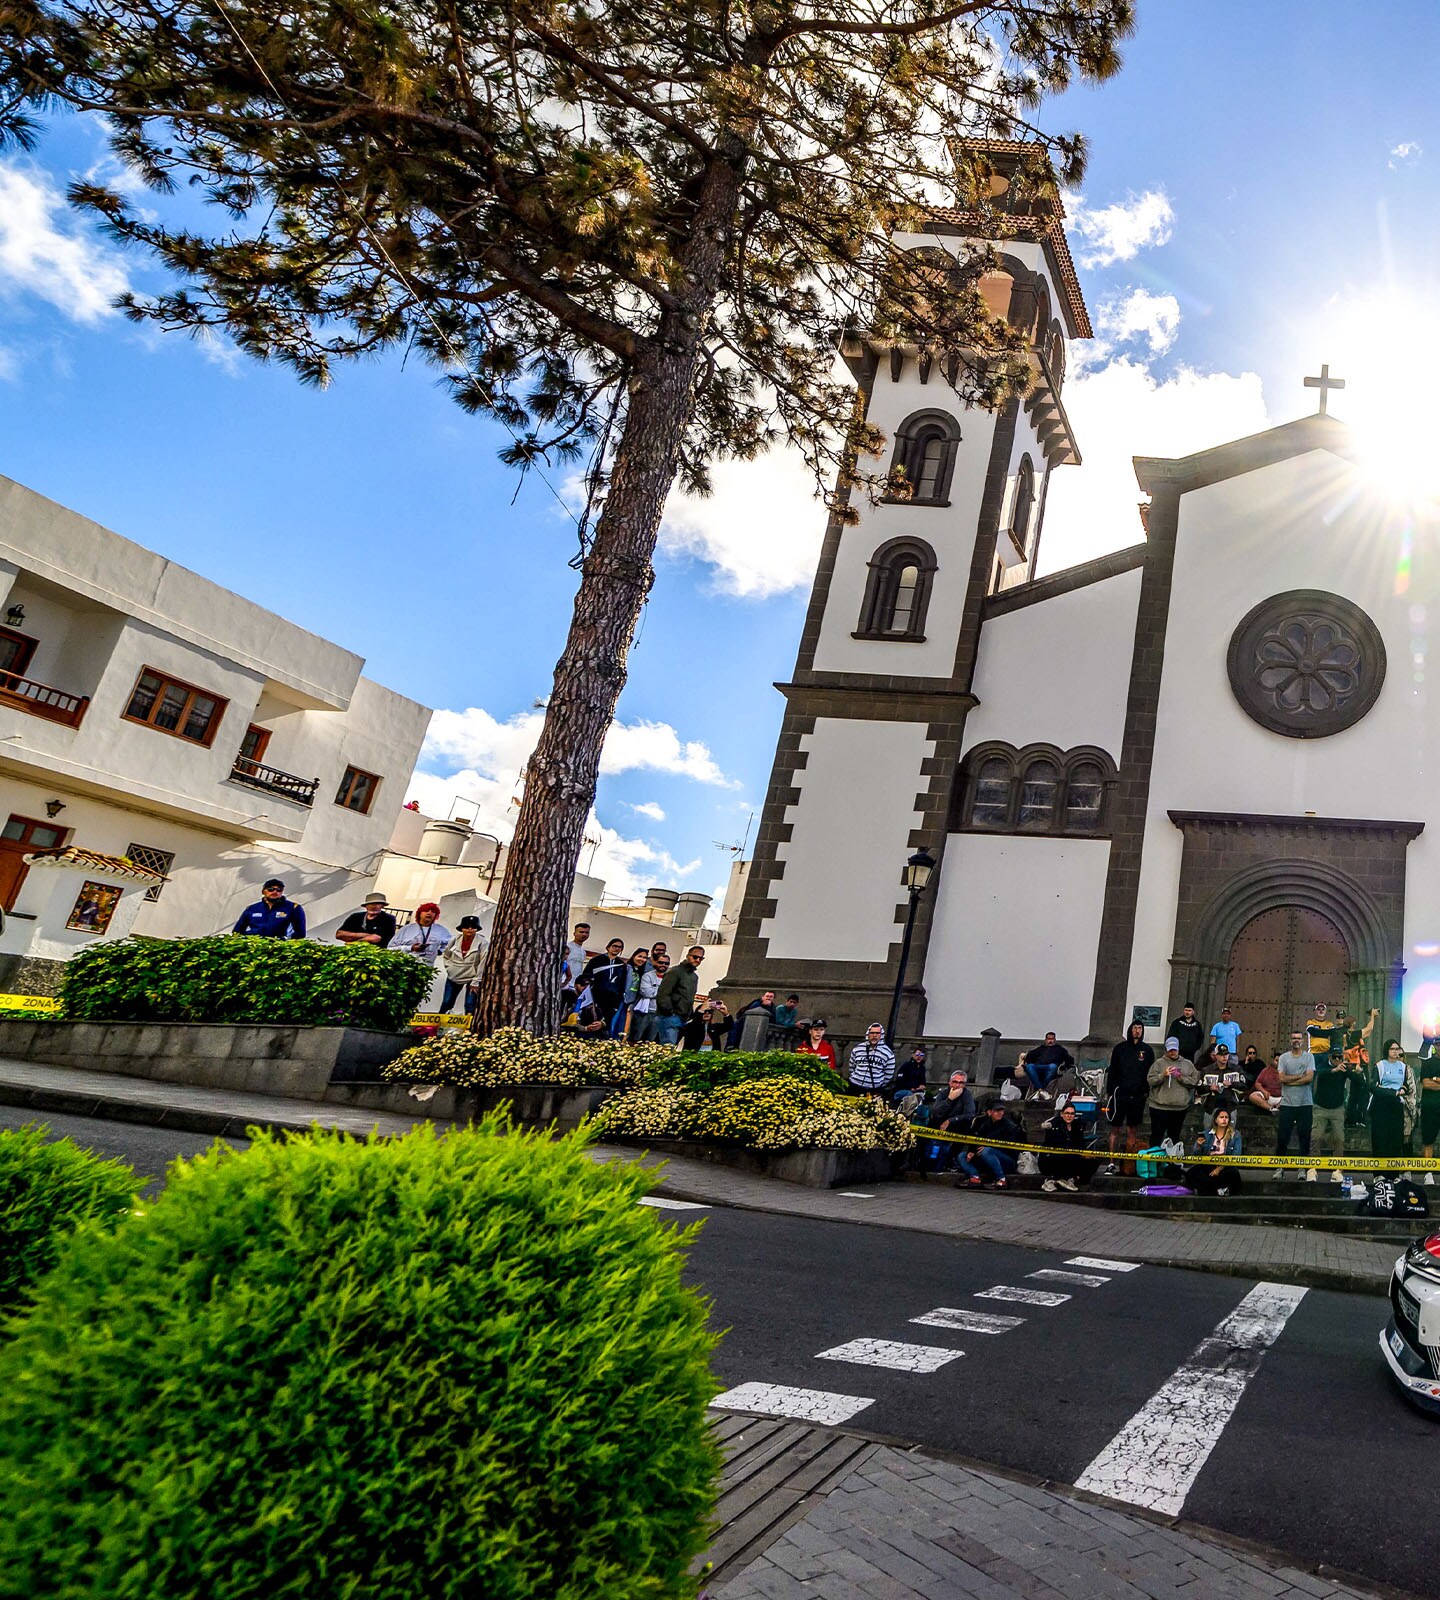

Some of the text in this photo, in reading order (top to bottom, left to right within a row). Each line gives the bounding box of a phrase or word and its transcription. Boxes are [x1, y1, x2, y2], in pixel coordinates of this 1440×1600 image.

[22, 998, 52, 1008] ZONA
[1231, 1157, 1263, 1165] PUBLICO
[1269, 1157, 1289, 1165] ZONA
[1290, 1158, 1322, 1166] PUBLICO
[1328, 1159, 1348, 1167] ZONA
[1349, 1159, 1380, 1168] PUBLICO
[1386, 1159, 1405, 1168] ZONA
[1407, 1159, 1438, 1168] PUBLICO
